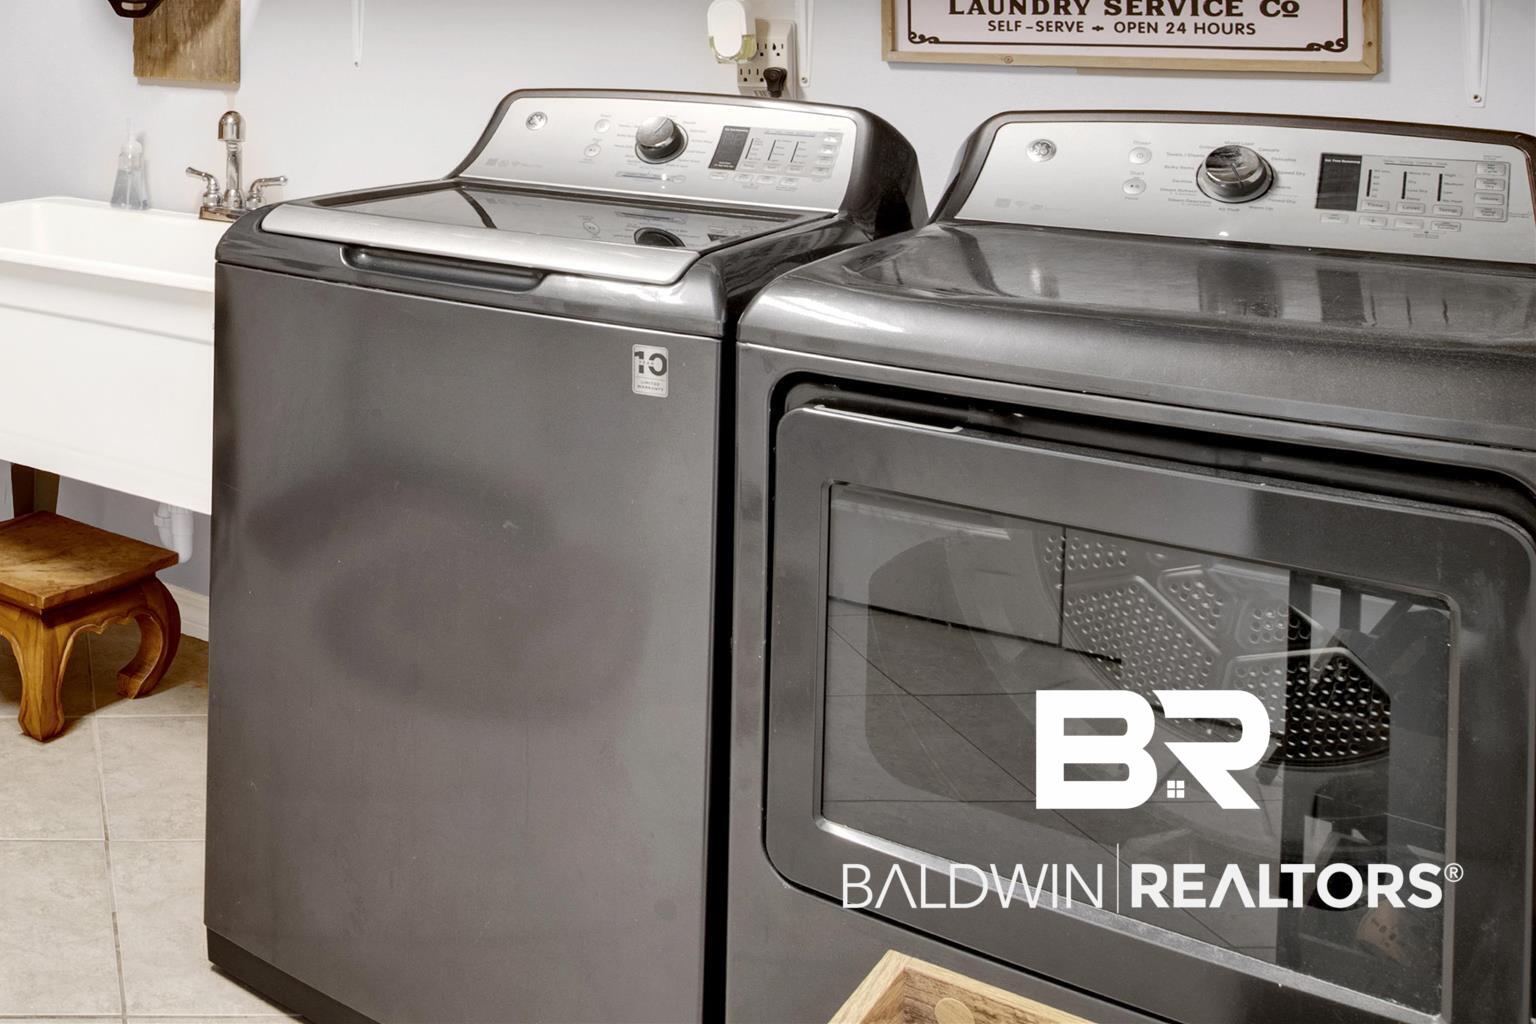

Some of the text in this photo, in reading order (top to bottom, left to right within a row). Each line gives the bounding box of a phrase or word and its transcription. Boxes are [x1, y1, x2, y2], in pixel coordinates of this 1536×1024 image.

[1114, 21, 1159, 35] OPEN
[1166, 22, 1187, 35] 24
[1194, 22, 1256, 36] HOURS
